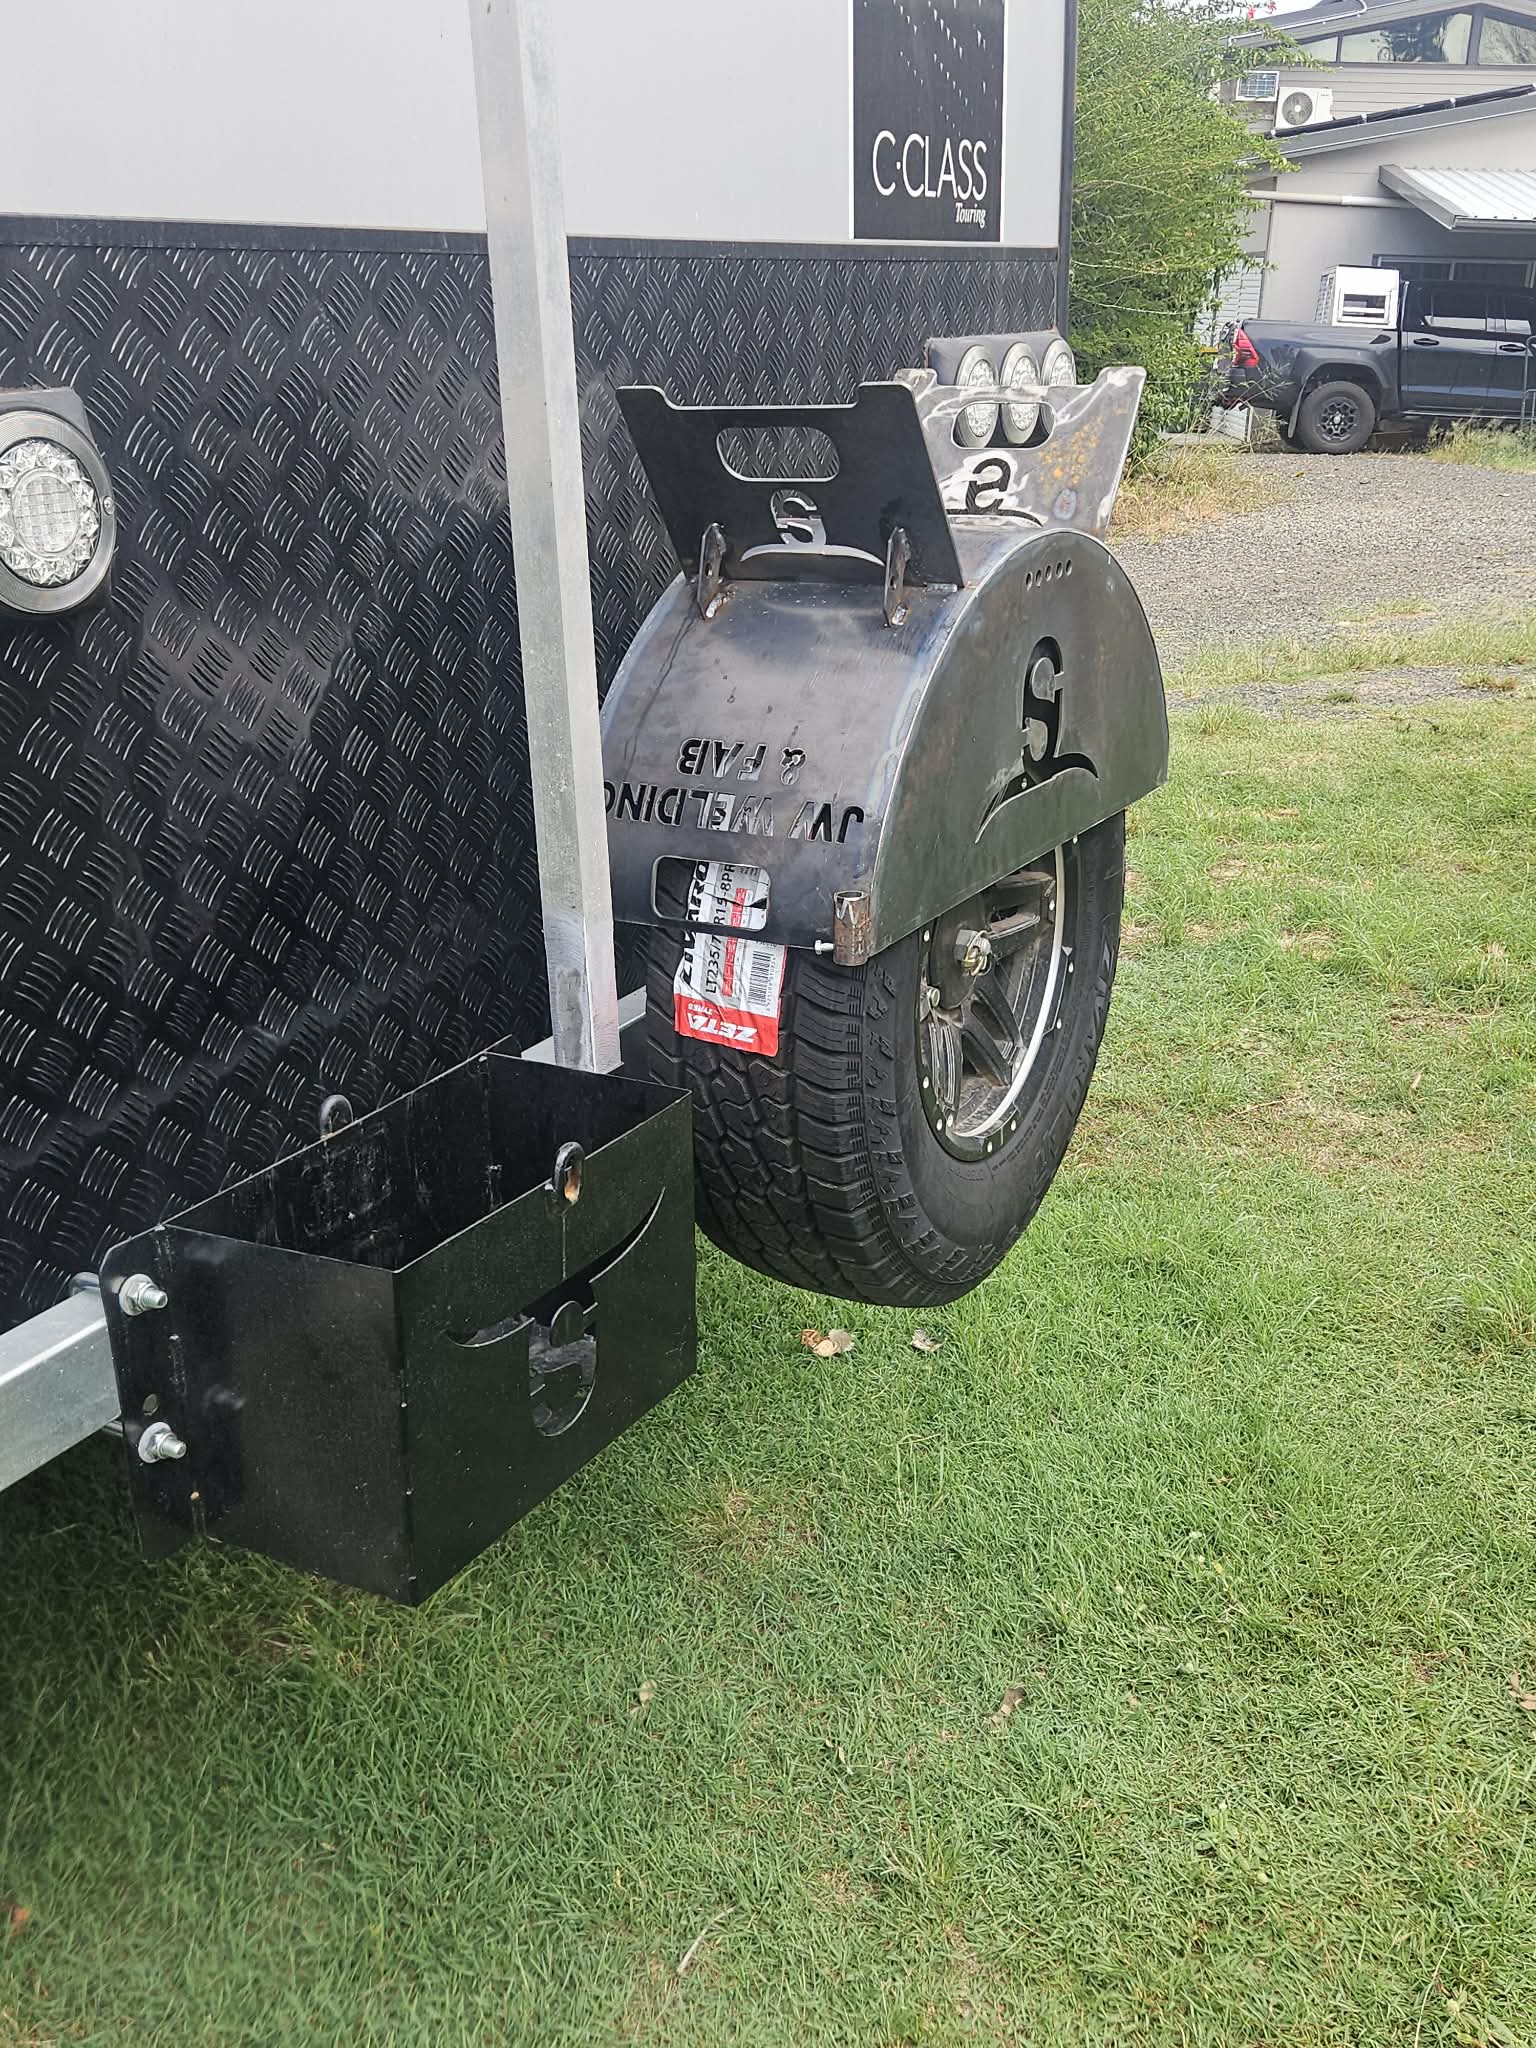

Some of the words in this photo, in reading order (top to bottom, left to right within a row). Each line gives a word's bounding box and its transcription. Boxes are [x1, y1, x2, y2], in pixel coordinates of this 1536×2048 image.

[955, 203, 987, 228] Touring
[676, 737, 768, 781] FAB
[780, 746, 807, 785] &
[788, 801, 865, 843] JW
[687, 1012, 758, 1043] ZETA
